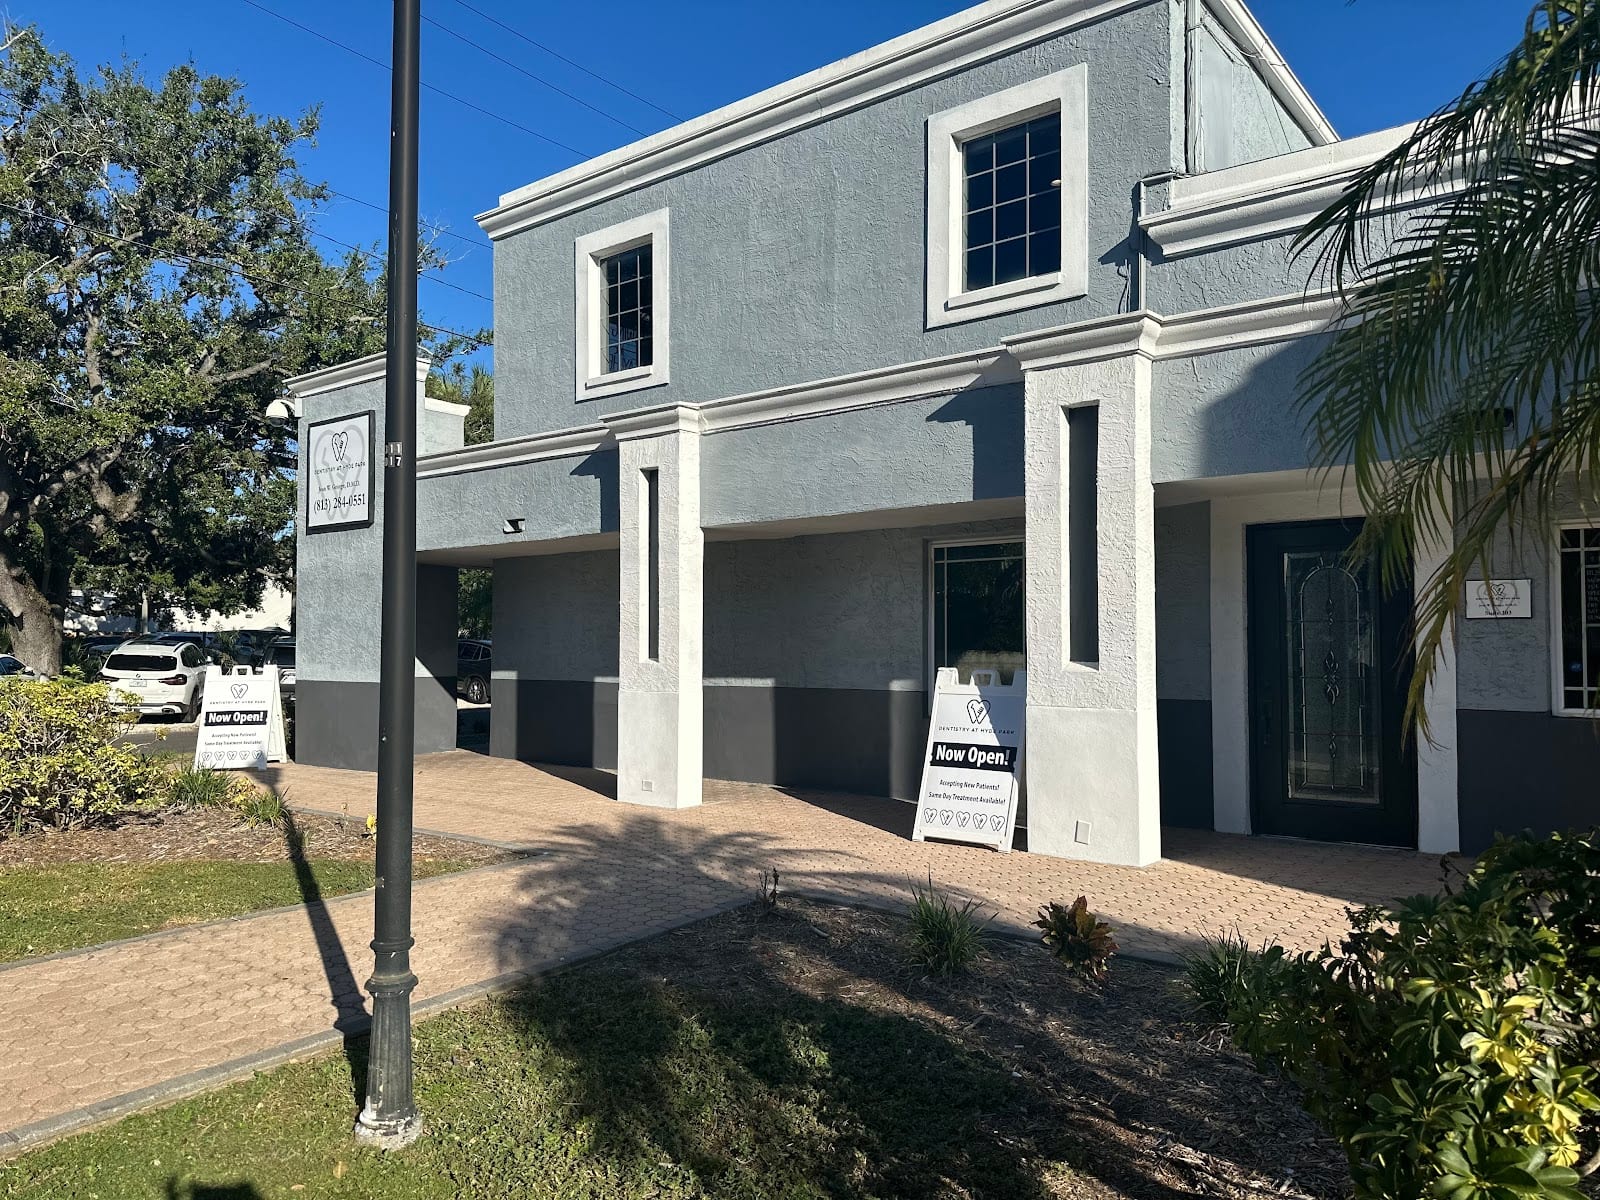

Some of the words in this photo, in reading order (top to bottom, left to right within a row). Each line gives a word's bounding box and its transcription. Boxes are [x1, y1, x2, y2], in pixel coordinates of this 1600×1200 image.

[313, 498, 331, 514] (813)
[333, 493, 366, 509] 284-0551
[208, 712, 232, 723] Now
[233, 711, 264, 725] Open!
[935, 744, 966, 762] Now
[967, 746, 1011, 768] Open!
[939, 779, 963, 789] Accepting
[963, 781, 976, 789] New
[975, 782, 1000, 791] Patients!
[928, 791, 942, 799] Same
[942, 792, 952, 801] Day
[952, 793, 979, 803] Treatment
[979, 796, 1006, 805] Available!
